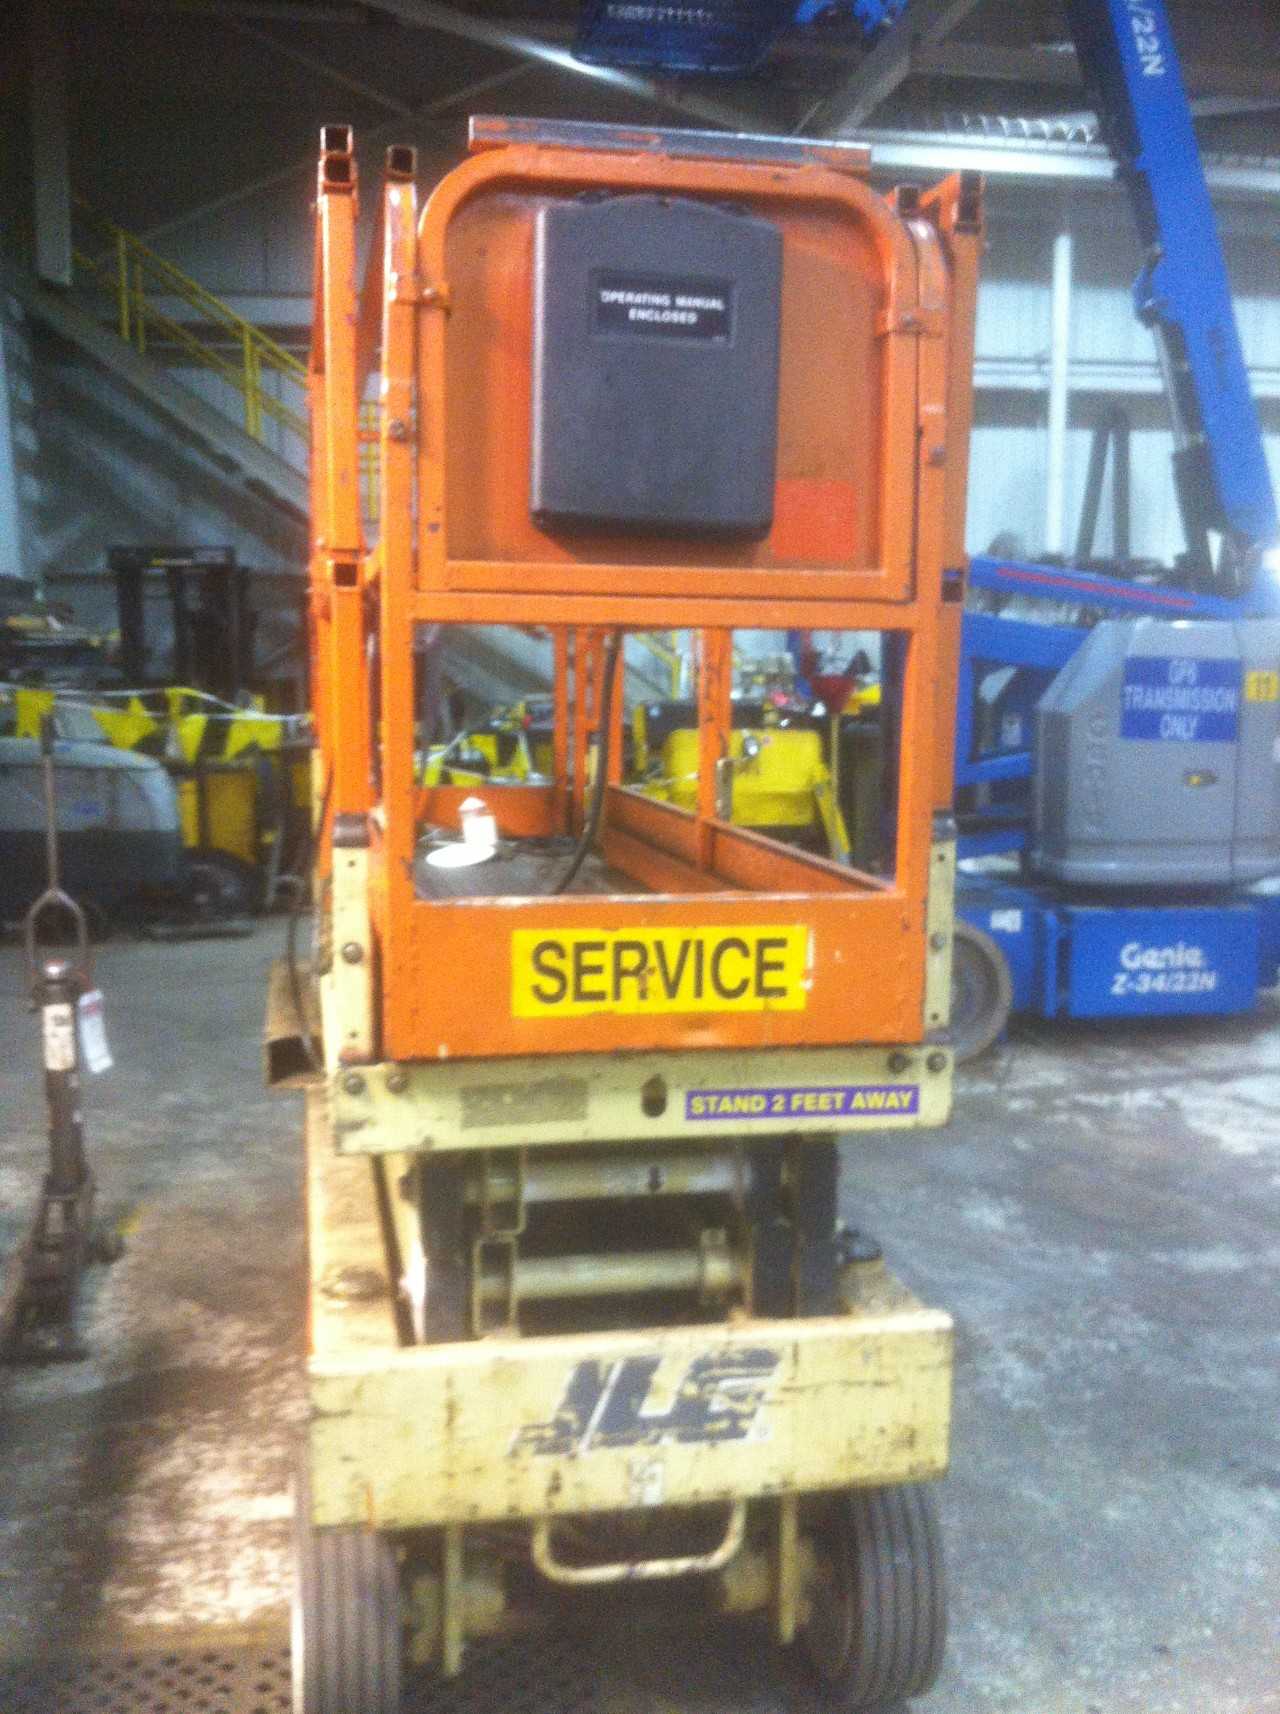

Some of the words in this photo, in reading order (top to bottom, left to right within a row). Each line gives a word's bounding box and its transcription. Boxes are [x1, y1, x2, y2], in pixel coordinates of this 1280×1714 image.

[1126, 0, 1167, 76] /22N
[601, 289, 671, 307] OPERATING
[675, 295, 725, 311] MANUAL
[628, 308, 698, 324] ENCLOSED
[1124, 684, 1238, 712] TRANSMISSION
[1159, 714, 1197, 740] ONLY
[1120, 942, 1202, 970] Genie
[531, 937, 788, 1004] SERVICE
[691, 1095, 766, 1114] STAND
[771, 1096, 785, 1112] 2
[791, 1093, 846, 1112] FEET
[851, 1091, 912, 1110] AWAY
